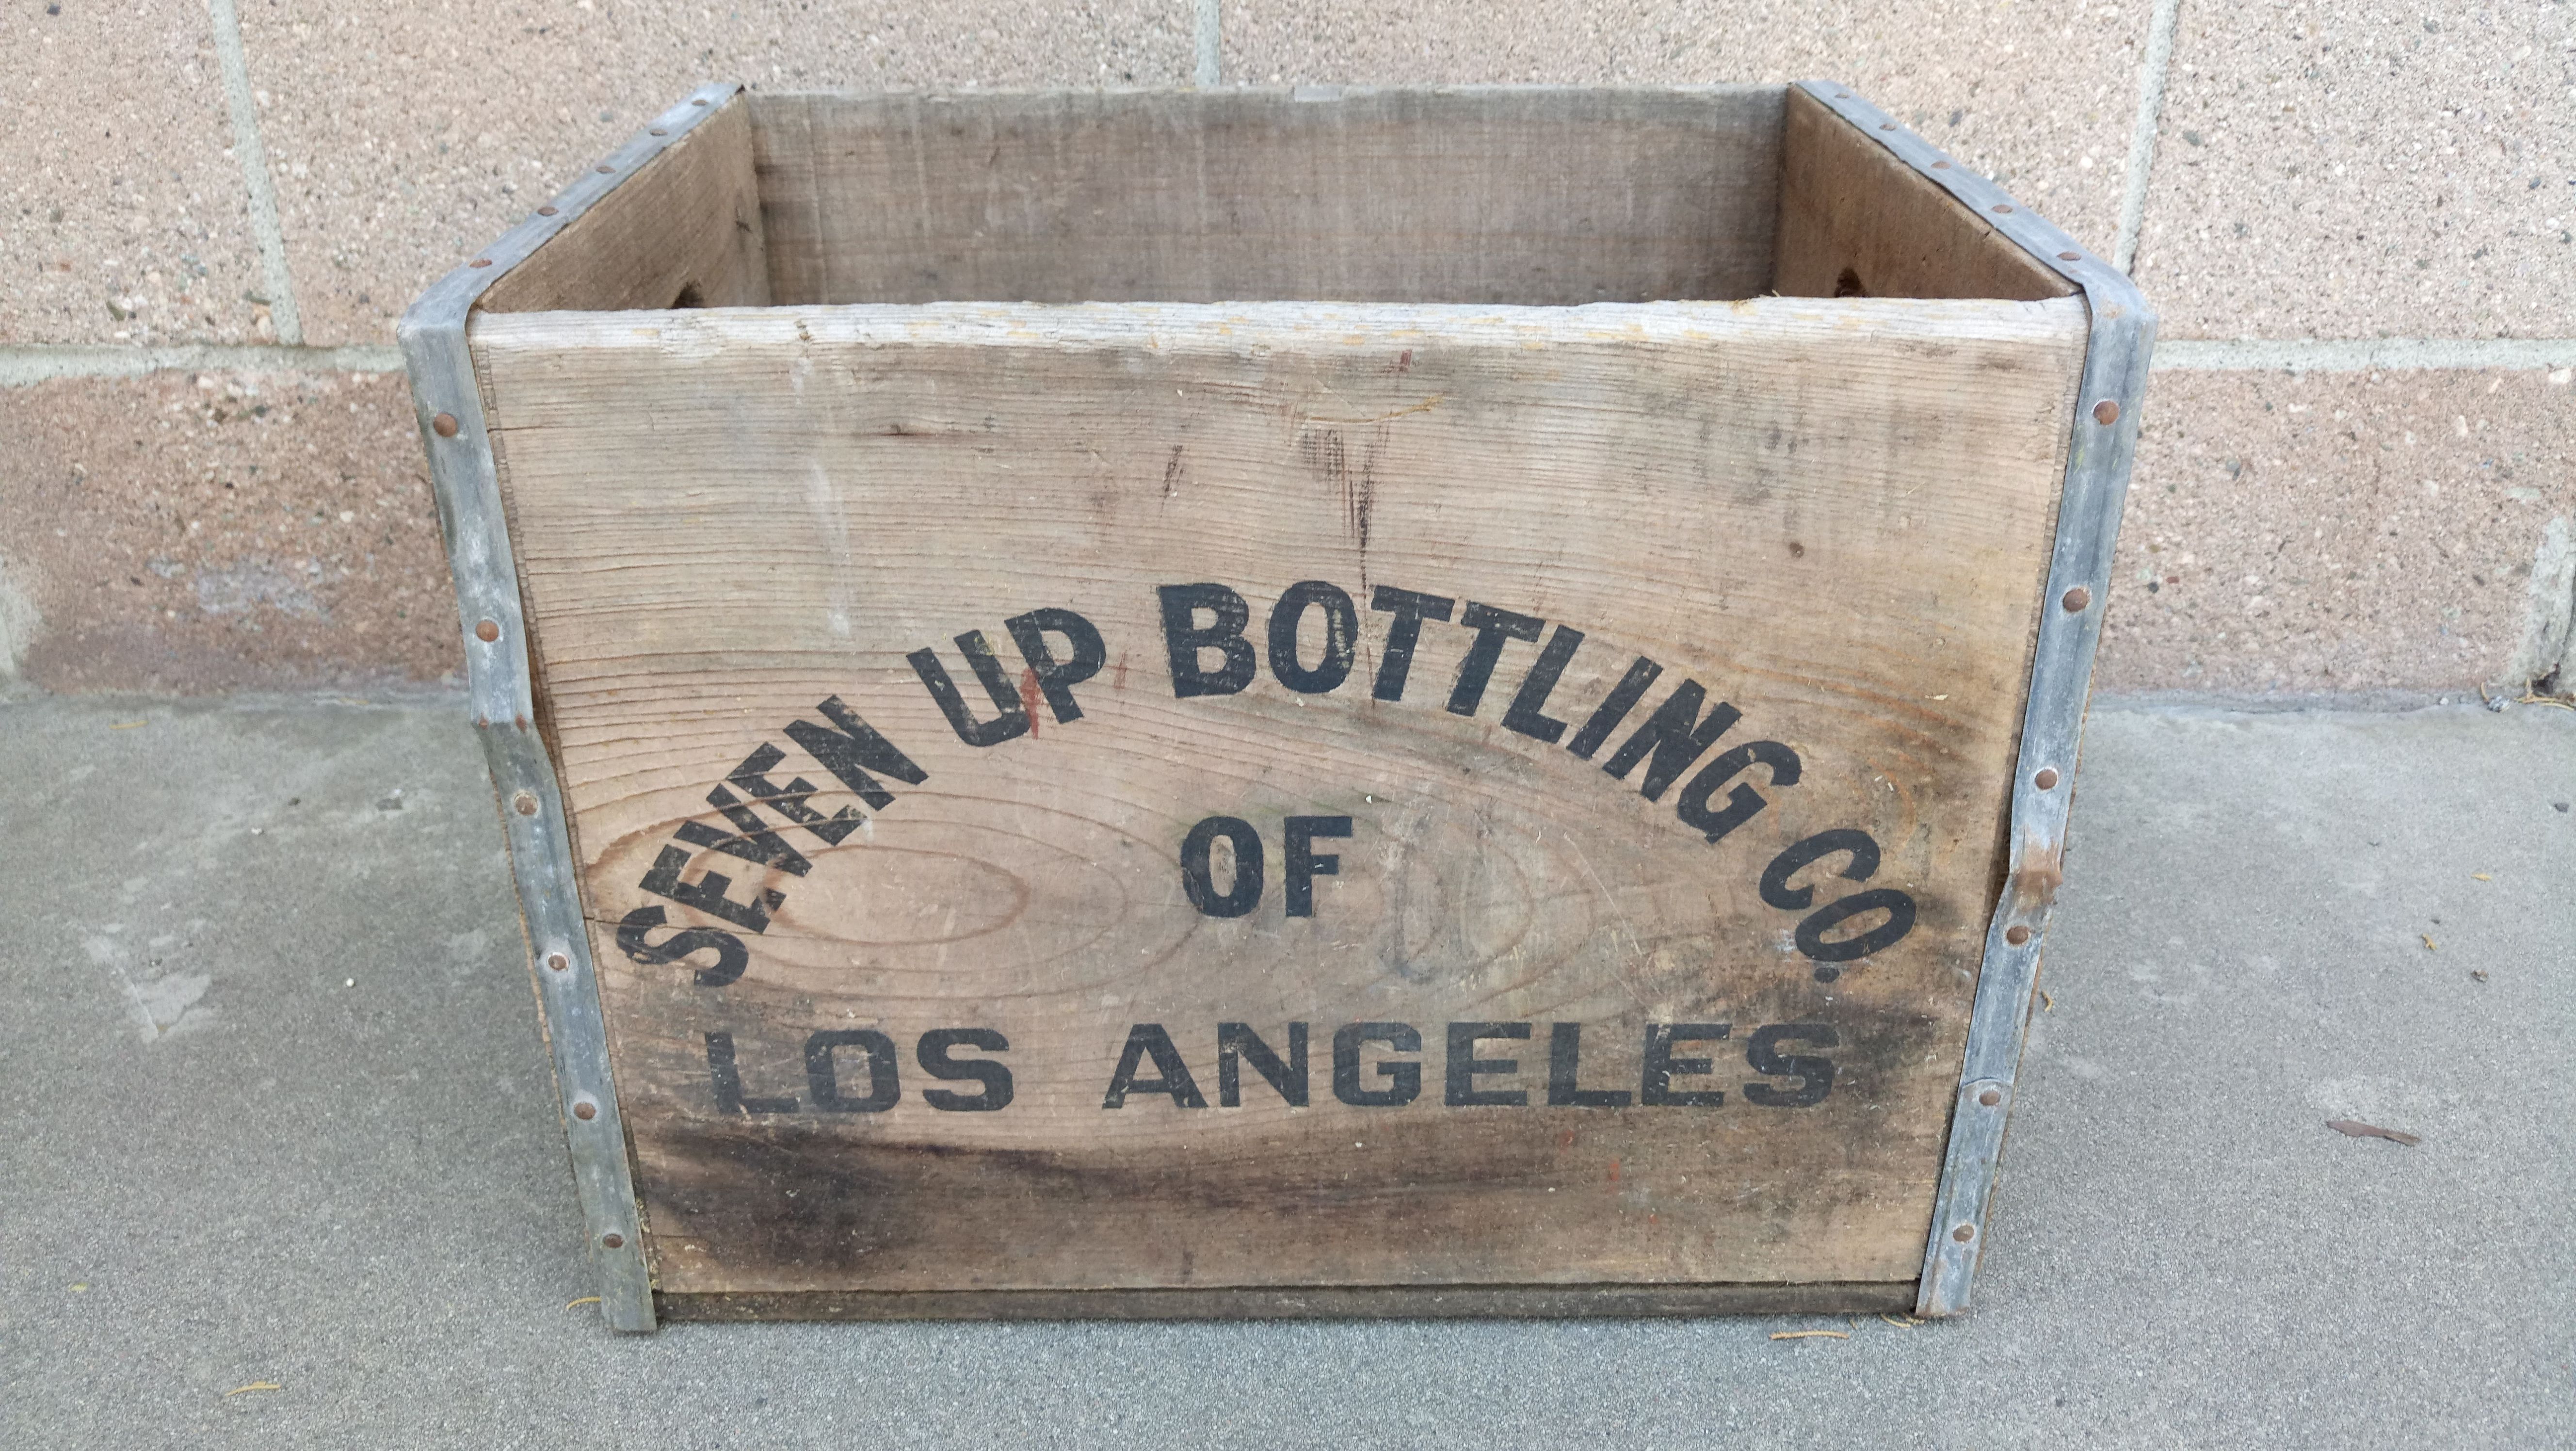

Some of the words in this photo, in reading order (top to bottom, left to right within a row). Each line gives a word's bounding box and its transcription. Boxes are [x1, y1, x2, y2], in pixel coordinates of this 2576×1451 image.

[616, 694, 929, 987] SEVEN
[906, 607, 1107, 747] UP
[1157, 580, 1802, 844] BOTTLING
[1759, 829, 1916, 983] CO.
[1180, 815, 1353, 919] OF
[705, 1028, 1014, 1114] LOS
[1101, 1021, 1841, 1110] ANGELES
